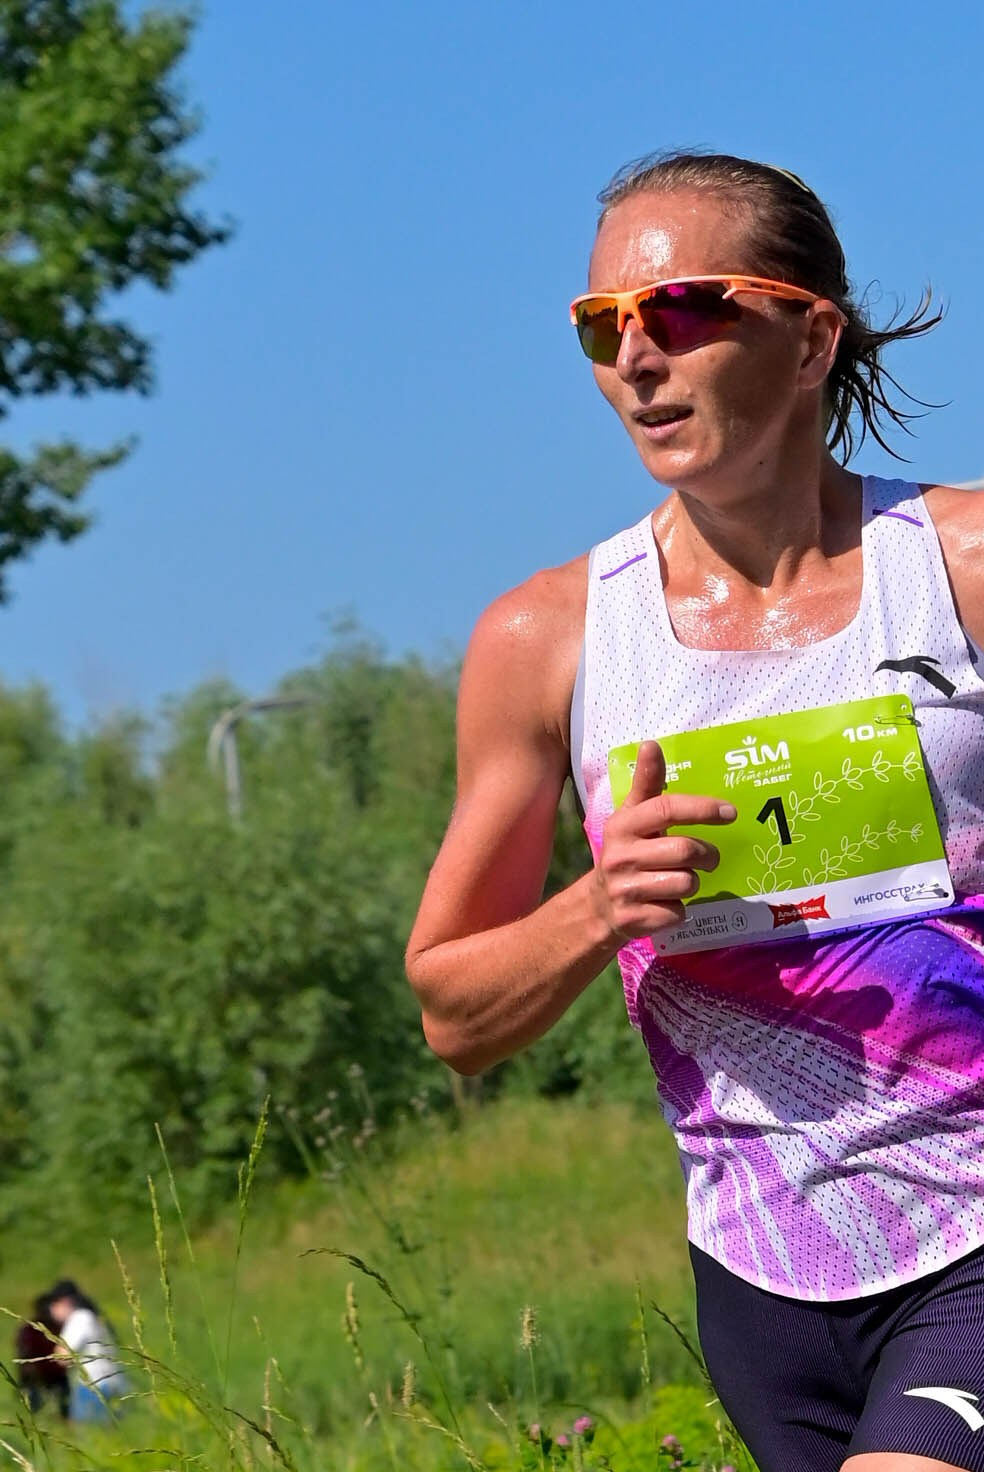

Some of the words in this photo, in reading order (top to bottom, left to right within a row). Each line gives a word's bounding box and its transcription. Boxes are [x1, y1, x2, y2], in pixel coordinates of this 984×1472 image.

[842, 725, 874, 743] 10
[753, 773, 792, 788] ЗАБЕГ
[756, 796, 792, 845] 1
[695, 913, 727, 928] ЦВЕТЫ
